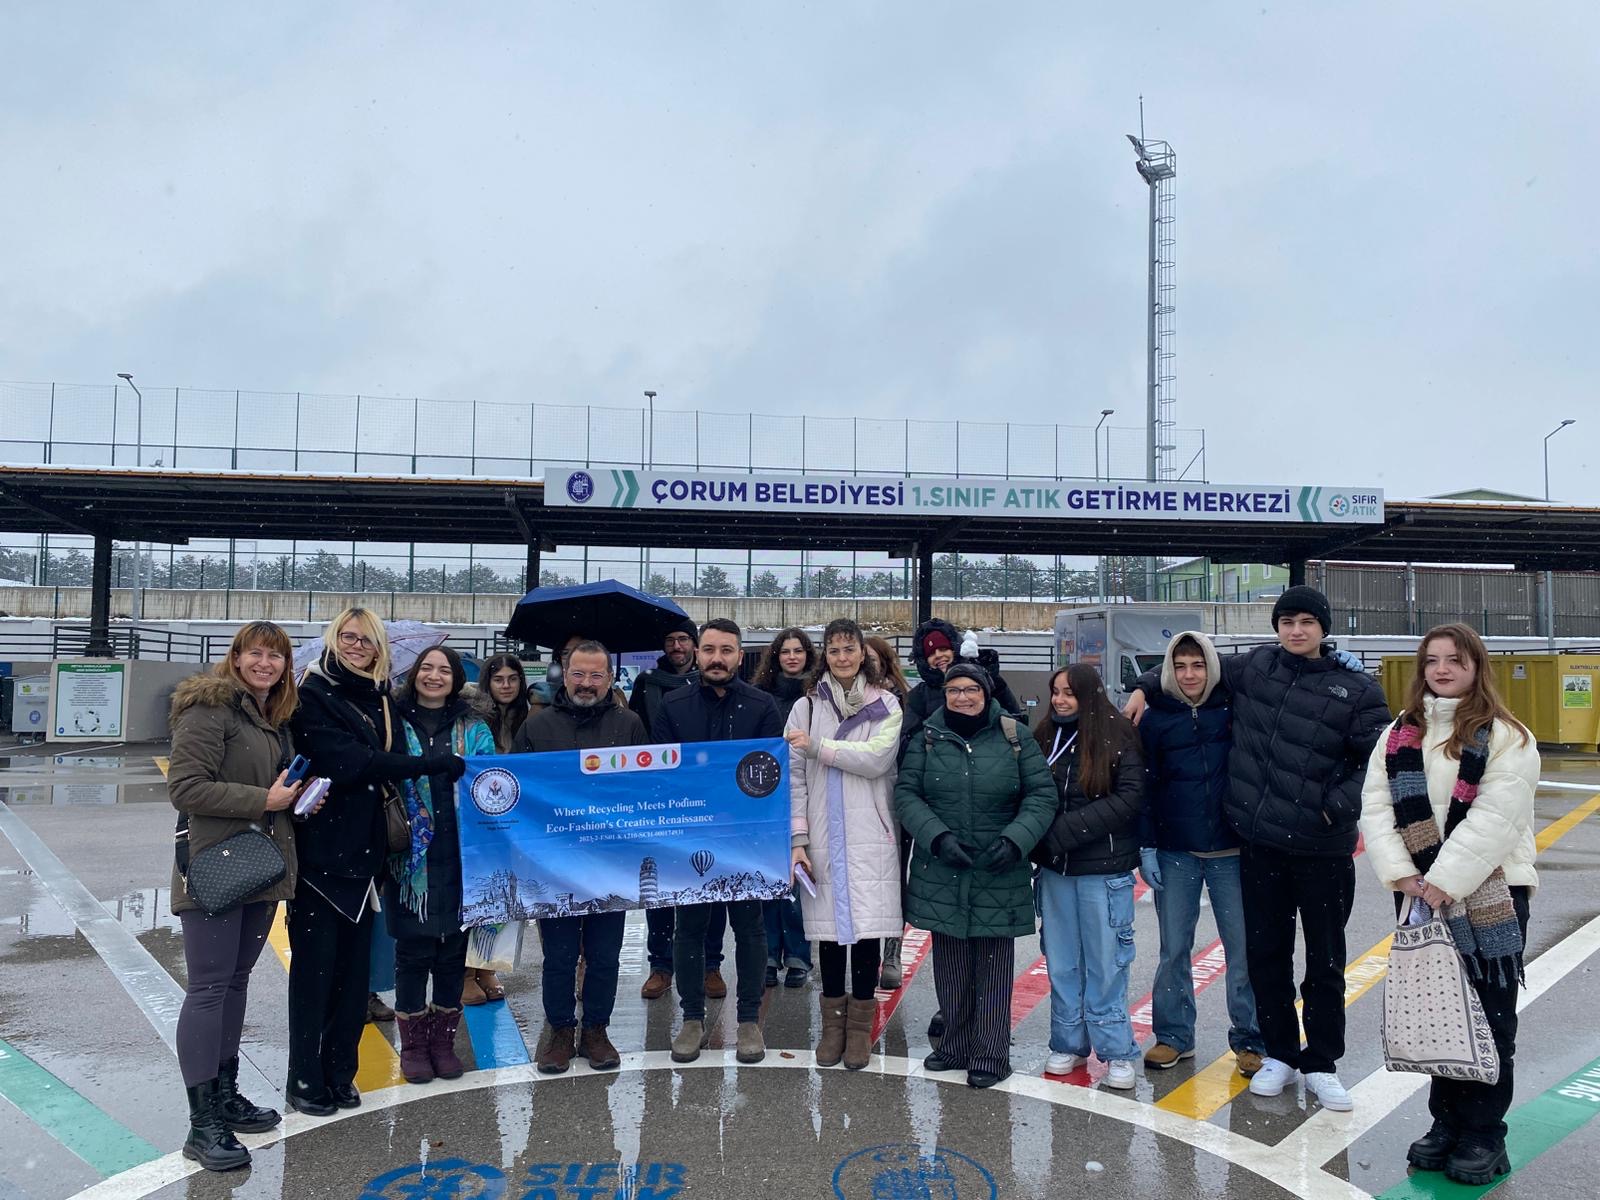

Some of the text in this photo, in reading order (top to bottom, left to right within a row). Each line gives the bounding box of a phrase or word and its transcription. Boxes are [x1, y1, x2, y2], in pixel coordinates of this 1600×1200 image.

[651, 479, 1291, 513] ÇORUM BELEDİYESİ 1.SINIF ATIK GETİRME MERKEZİ
[1352, 495, 1377, 504] SIFIR
[1352, 506, 1377, 516] ATIK
[554, 798, 707, 817] Where Recycling Meets Podium:
[546, 814, 714, 833] Eco-Fashion's Creative Renaissance
